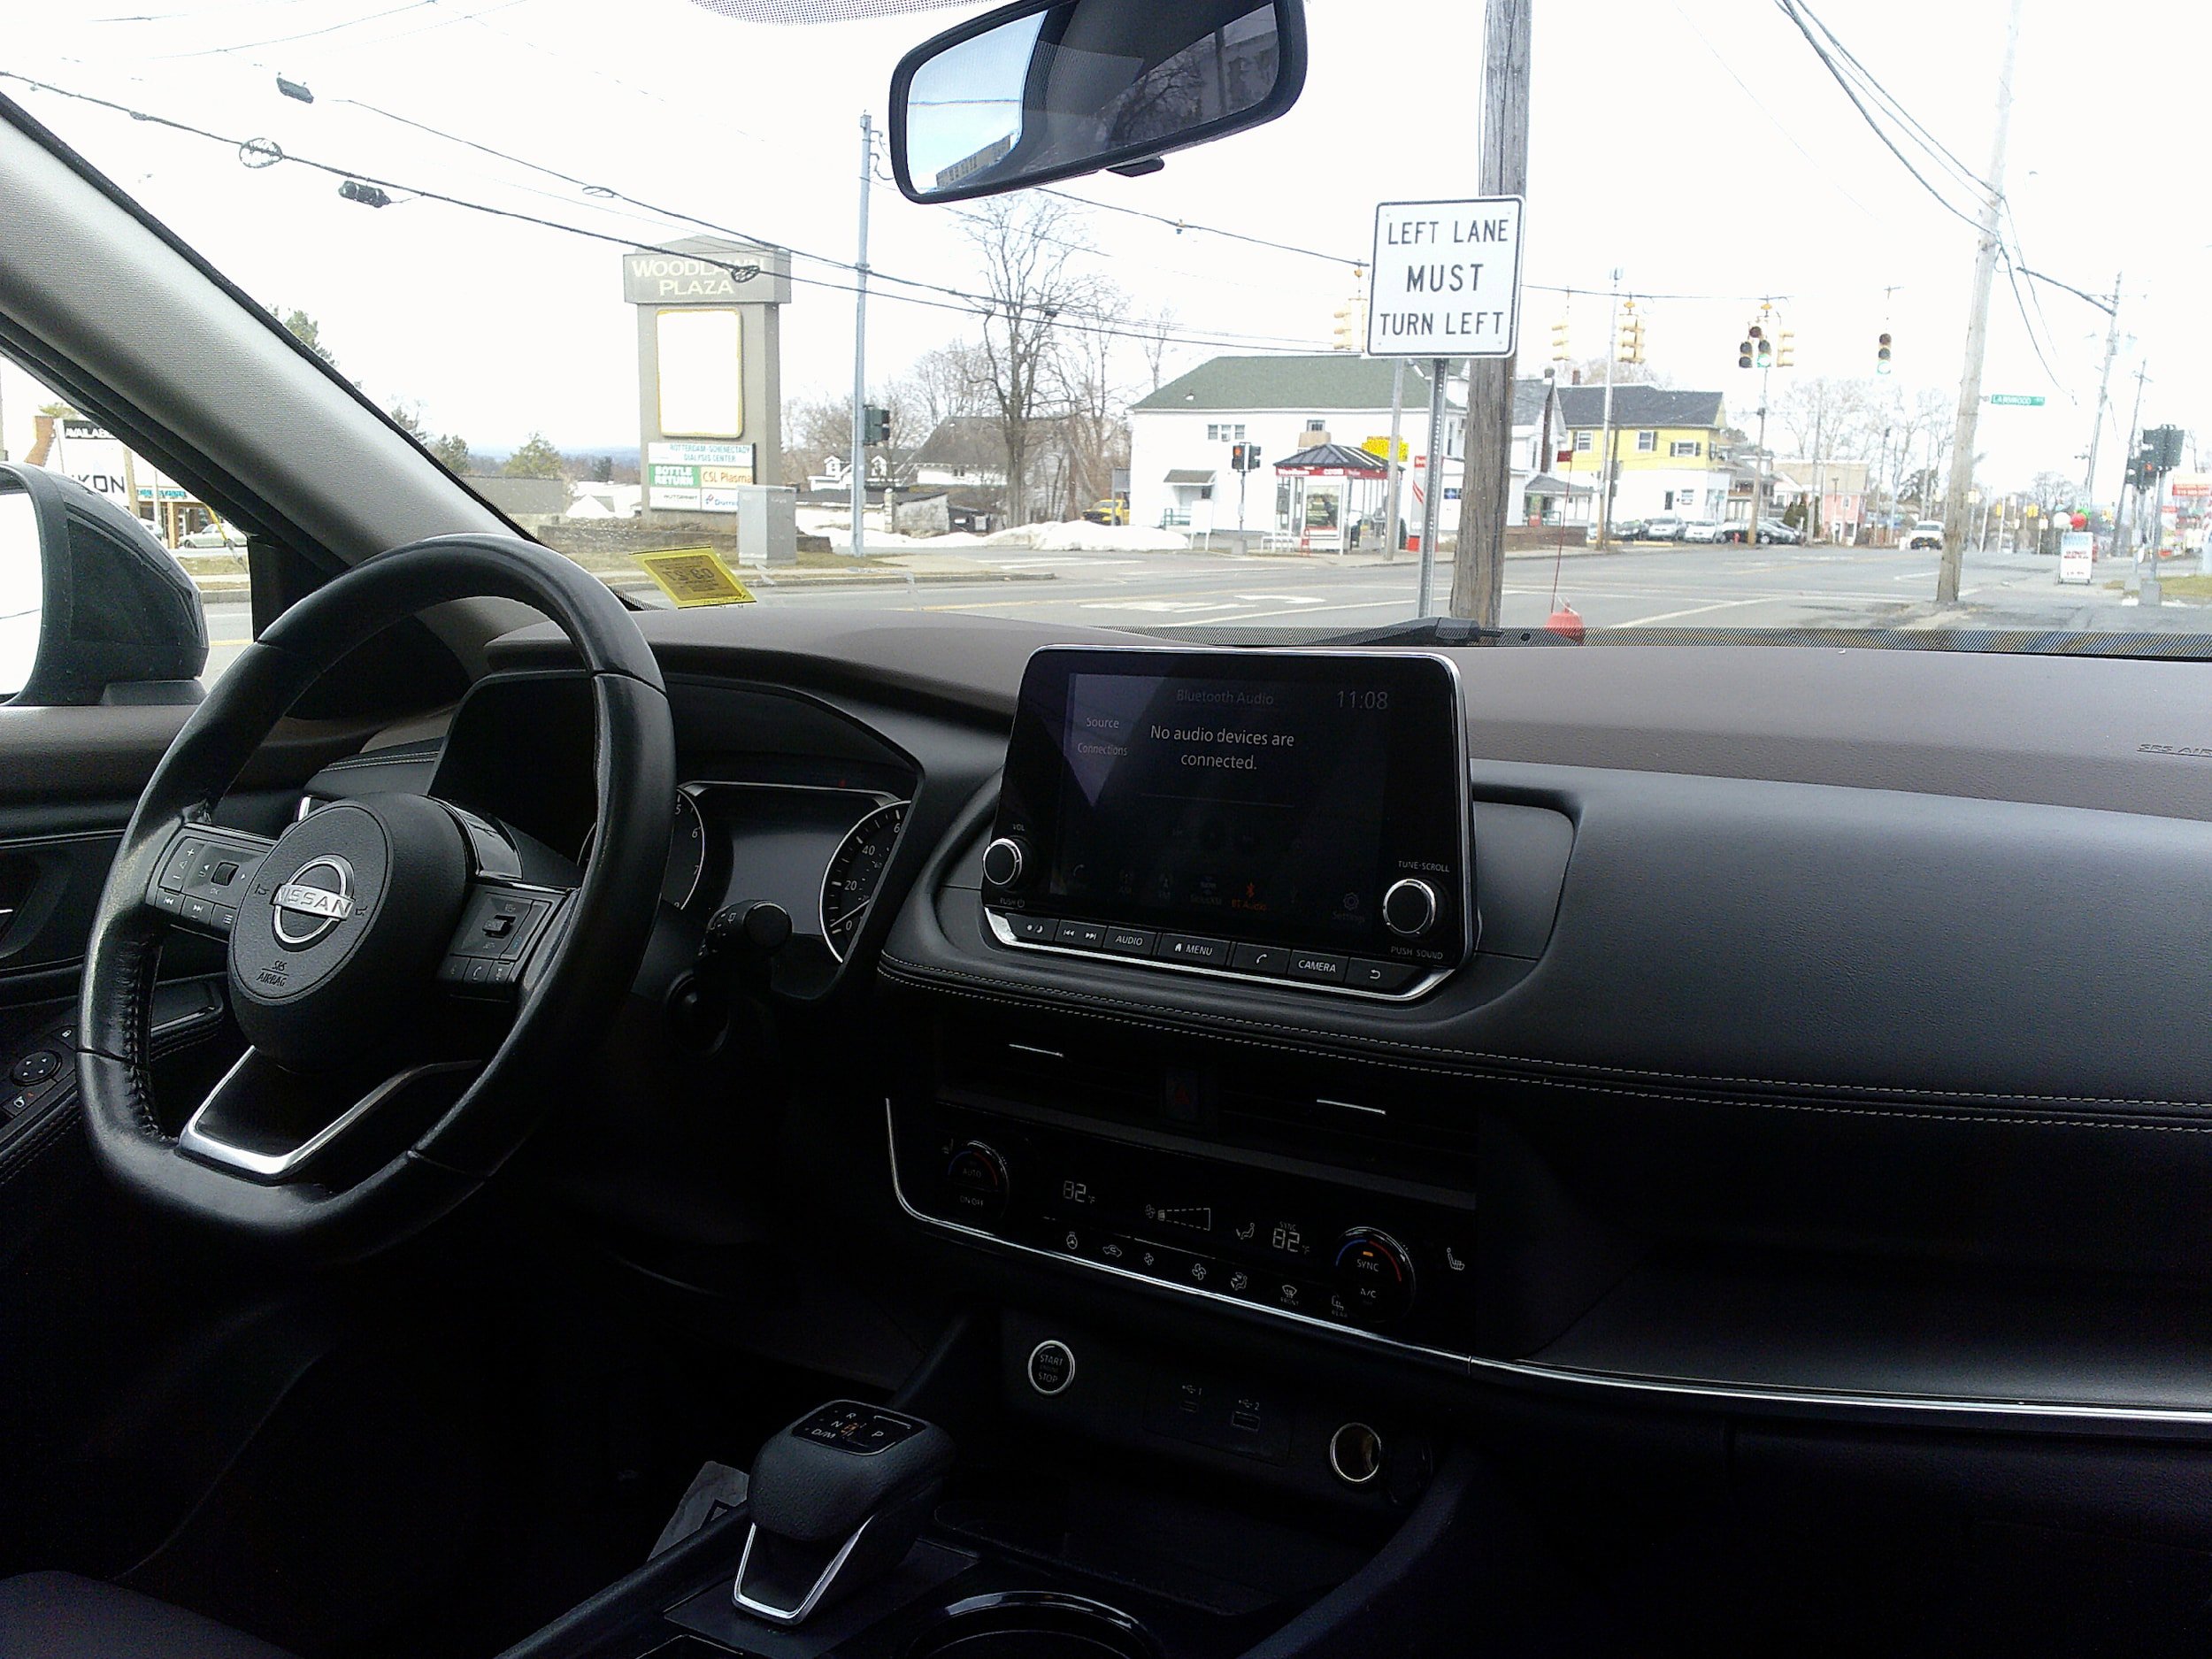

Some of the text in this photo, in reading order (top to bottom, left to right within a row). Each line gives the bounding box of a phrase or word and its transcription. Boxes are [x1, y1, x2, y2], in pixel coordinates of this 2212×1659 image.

[1388, 219, 1509, 244] LEFT LANE
[1407, 264, 1484, 292] MUST
[658, 279, 734, 296] PLAZA
[1380, 311, 1503, 335] TURN LEFT
[65, 427, 115, 438] AVAILAB
[655, 466, 692, 476] BOTTLE
[703, 472, 753, 484] CSL Plasma
[1177, 688, 1274, 705] Bluetooth Audio
[1336, 690, 1388, 710] 11:08
[1086, 716, 1120, 729] Source
[1149, 724, 1295, 748] No audio devices are
[1077, 741, 1128, 757] Connections
[1180, 753, 1257, 771] connected.
[861, 844, 876, 856] 40
[844, 879, 857, 891] 20
[273, 887, 352, 917] NISSAN
[846, 920, 853, 931] 0
[1115, 933, 1144, 947] AUDIO
[1185, 943, 1214, 956] MENU
[1390, 946, 1444, 960] PUSH SOUND
[1297, 958, 1337, 973] CAMERA
[256, 972, 288, 987] AIRBAG
[962, 1168, 982, 1179] AUTO
[1356, 1258, 1380, 1272] SYNC
[1360, 1287, 1377, 1299] A/C
[1040, 1354, 1064, 1367] START
[1038, 1371, 1059, 1383] STOP
